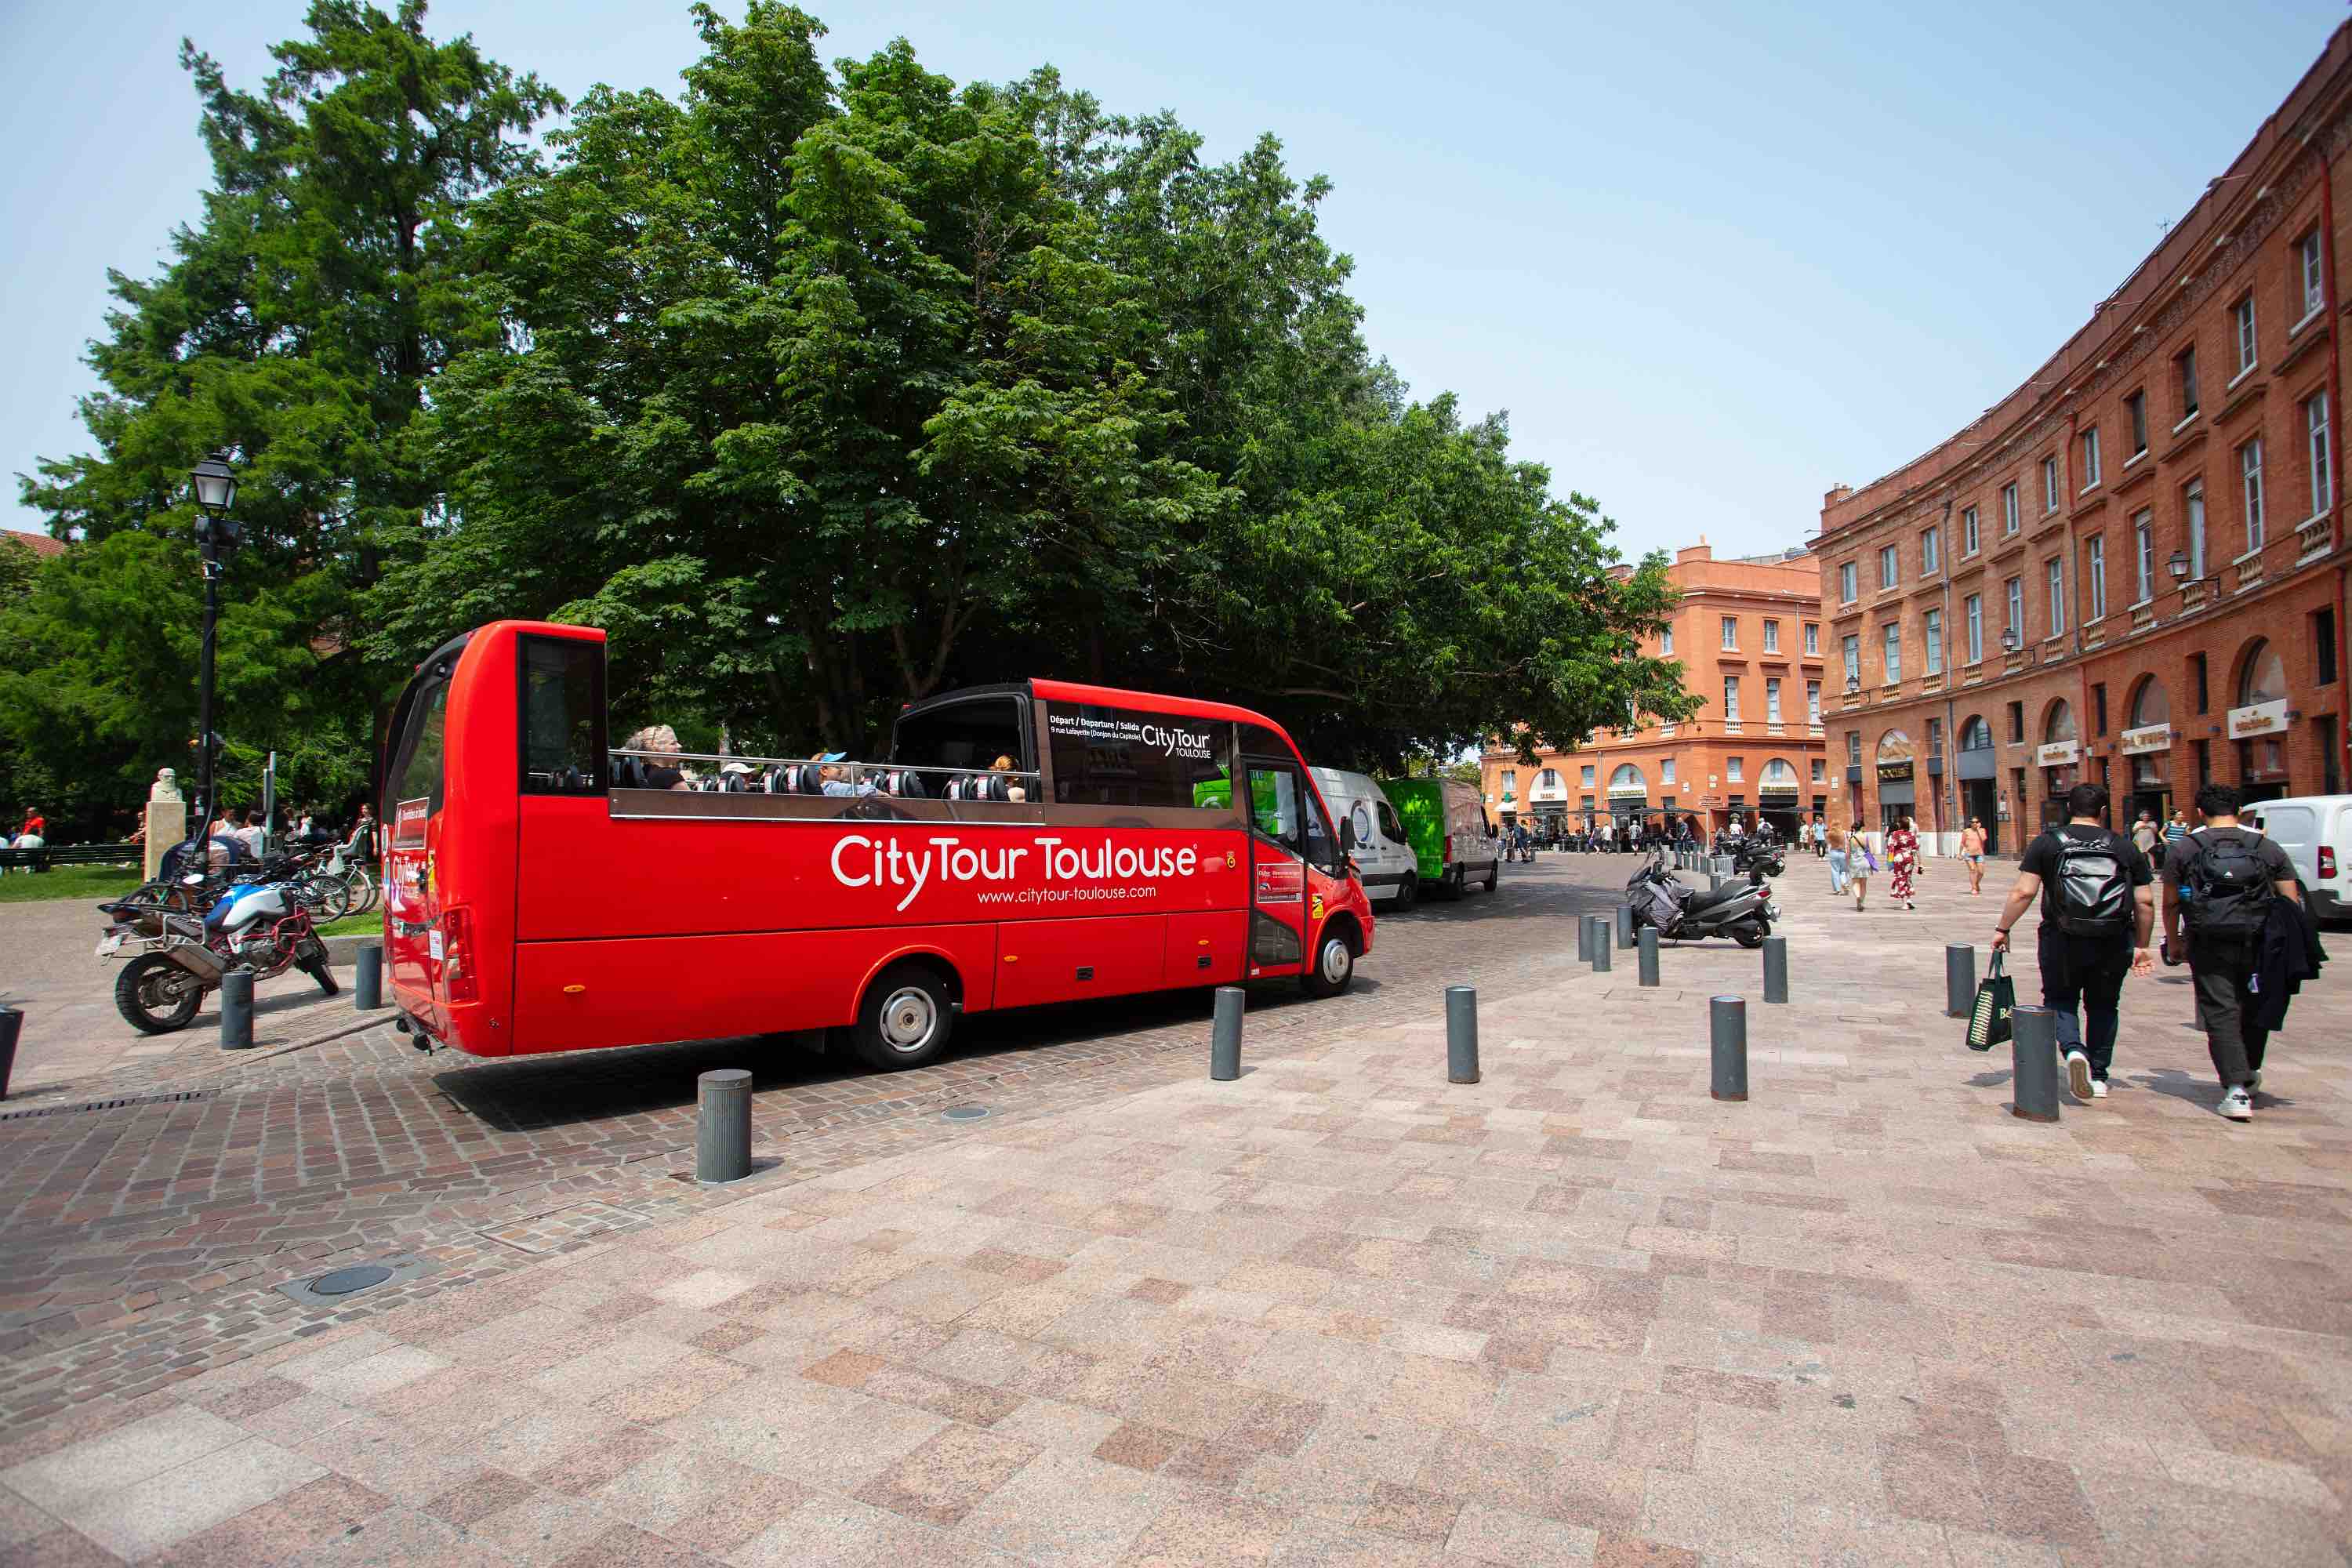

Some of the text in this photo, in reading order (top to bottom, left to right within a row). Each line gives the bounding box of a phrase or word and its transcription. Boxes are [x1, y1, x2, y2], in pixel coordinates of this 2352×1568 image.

[1050, 715, 1074, 725] Départ
[1080, 718, 1115, 728] Departure
[1120, 722, 1140, 731] Salida
[1065, 728, 1091, 736] Lafayette
[1091, 730, 1111, 739] (Donjon
[1142, 724, 1210, 757] CityTour
[1176, 747, 1210, 759] TOULOUSE
[831, 835, 1197, 912] CityTour Toulouse
[978, 885, 1156, 906] www.citytour-toulouse.com
